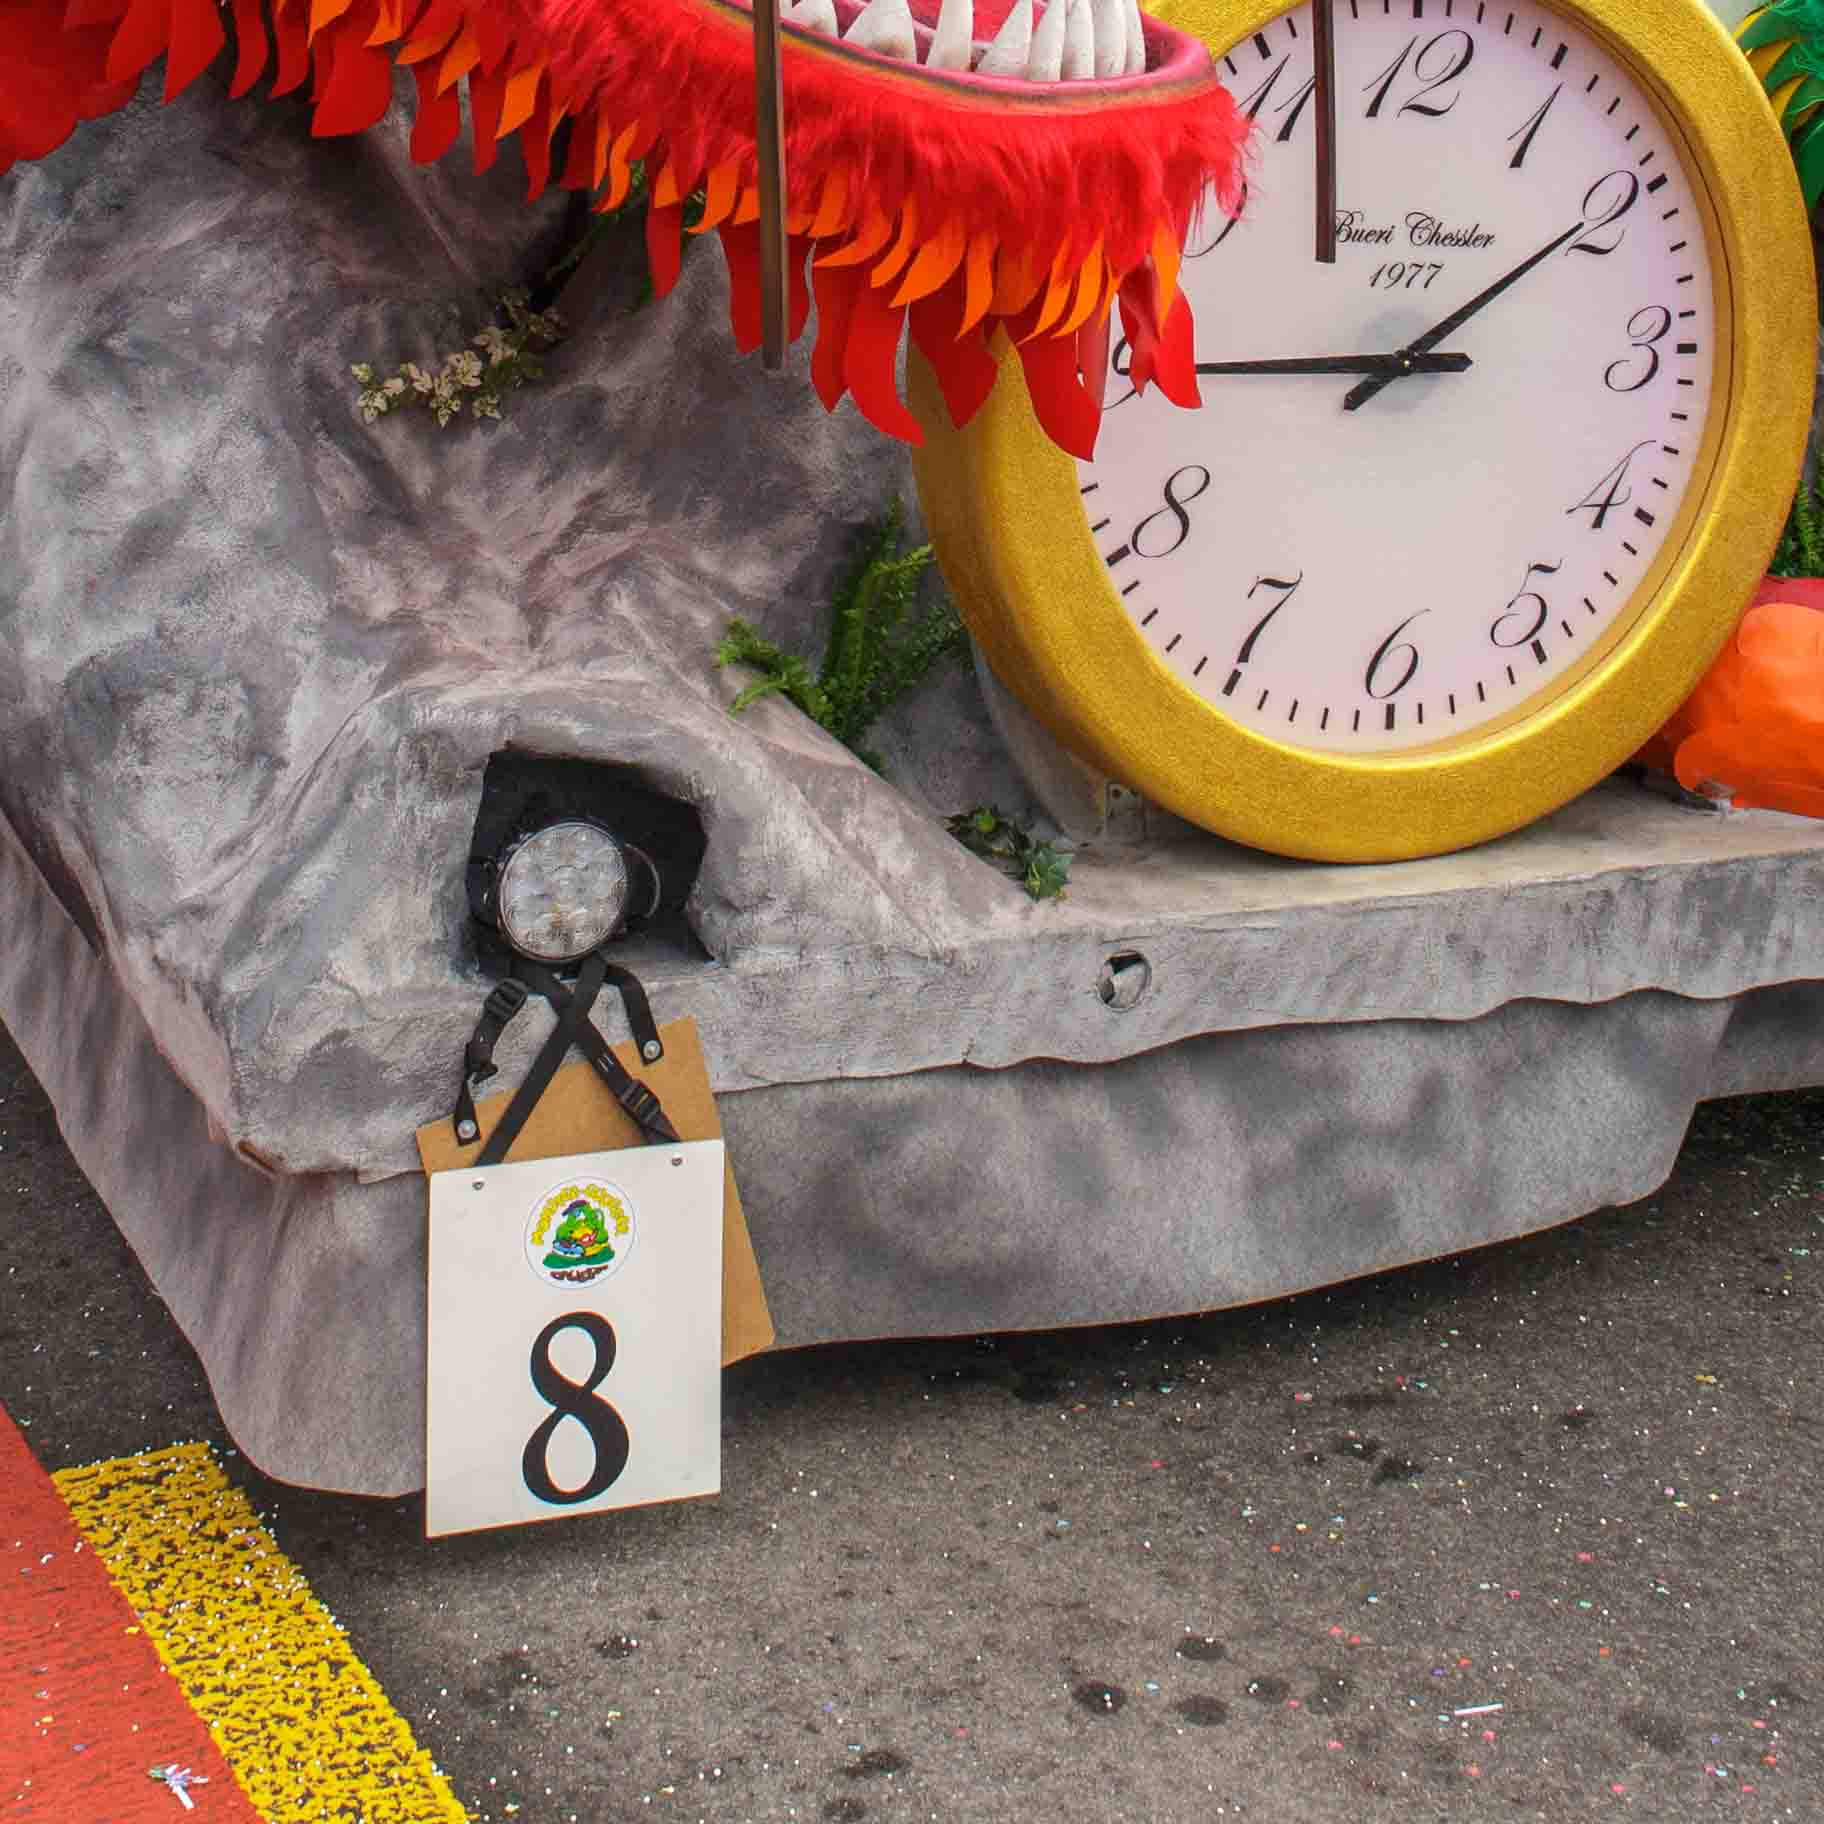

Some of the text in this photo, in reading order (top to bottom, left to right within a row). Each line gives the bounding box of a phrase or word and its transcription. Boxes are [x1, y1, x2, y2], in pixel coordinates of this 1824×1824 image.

[1237, 52, 1316, 143] 11
[1364, 29, 1474, 118] 12
[1509, 82, 1564, 169] 1
[1404, 210, 1496, 249] Chessler
[1567, 169, 1640, 256] 2
[1369, 261, 1445, 289] 1977
[1604, 305, 1672, 392] 3
[1130, 464, 1211, 558] 8
[1565, 439, 1658, 530] 4
[1236, 570, 1304, 664] 7
[1490, 557, 1564, 649] 5
[1364, 607, 1433, 700] 6
[521, 1310, 631, 1506] 8
